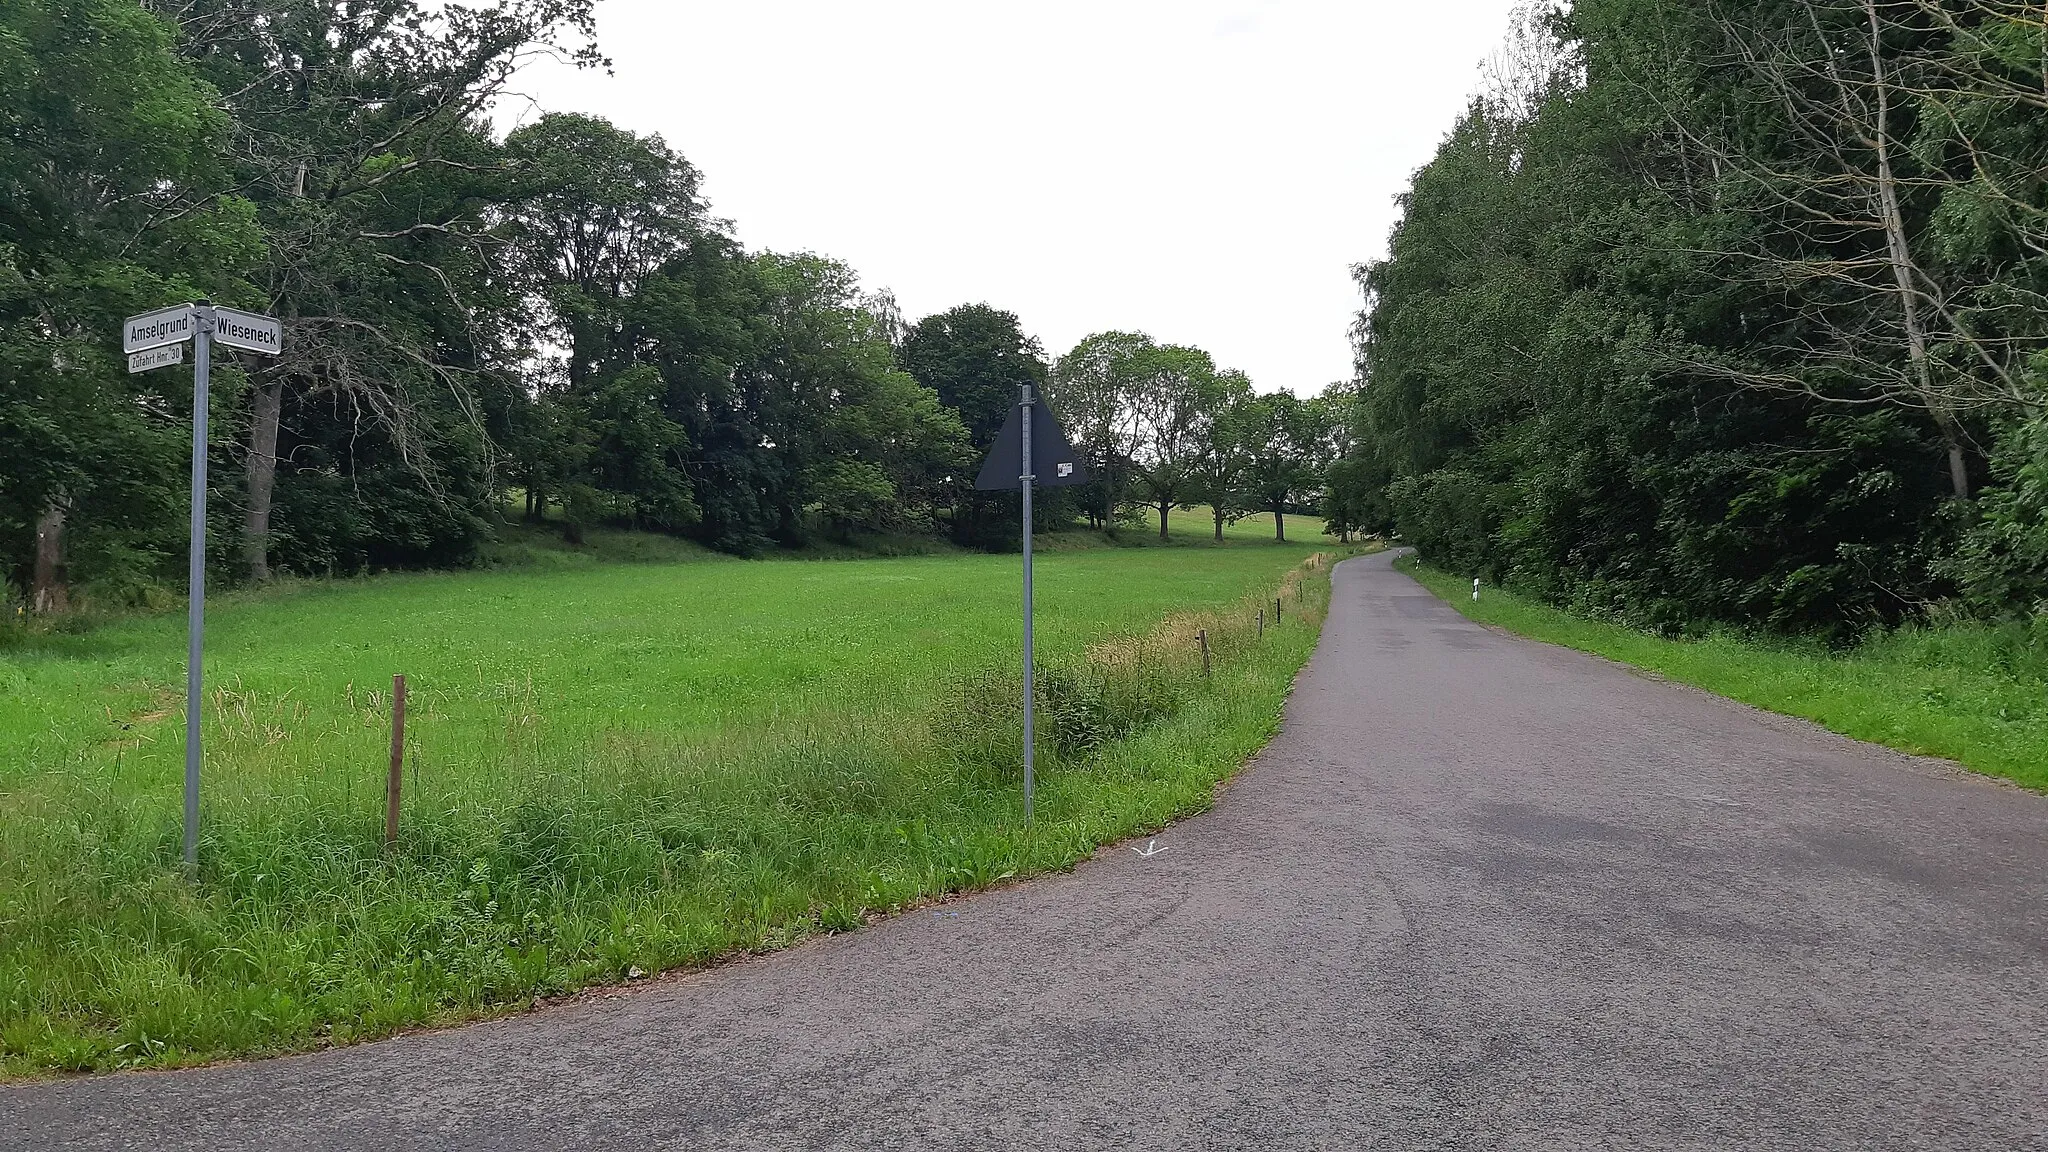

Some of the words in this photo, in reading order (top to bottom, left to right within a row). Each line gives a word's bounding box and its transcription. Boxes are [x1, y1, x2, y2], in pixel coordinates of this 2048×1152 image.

[131, 313, 188, 343] Amselgrund
[217, 316, 277, 346] Wieseneck
[171, 347, 180, 360] 30
